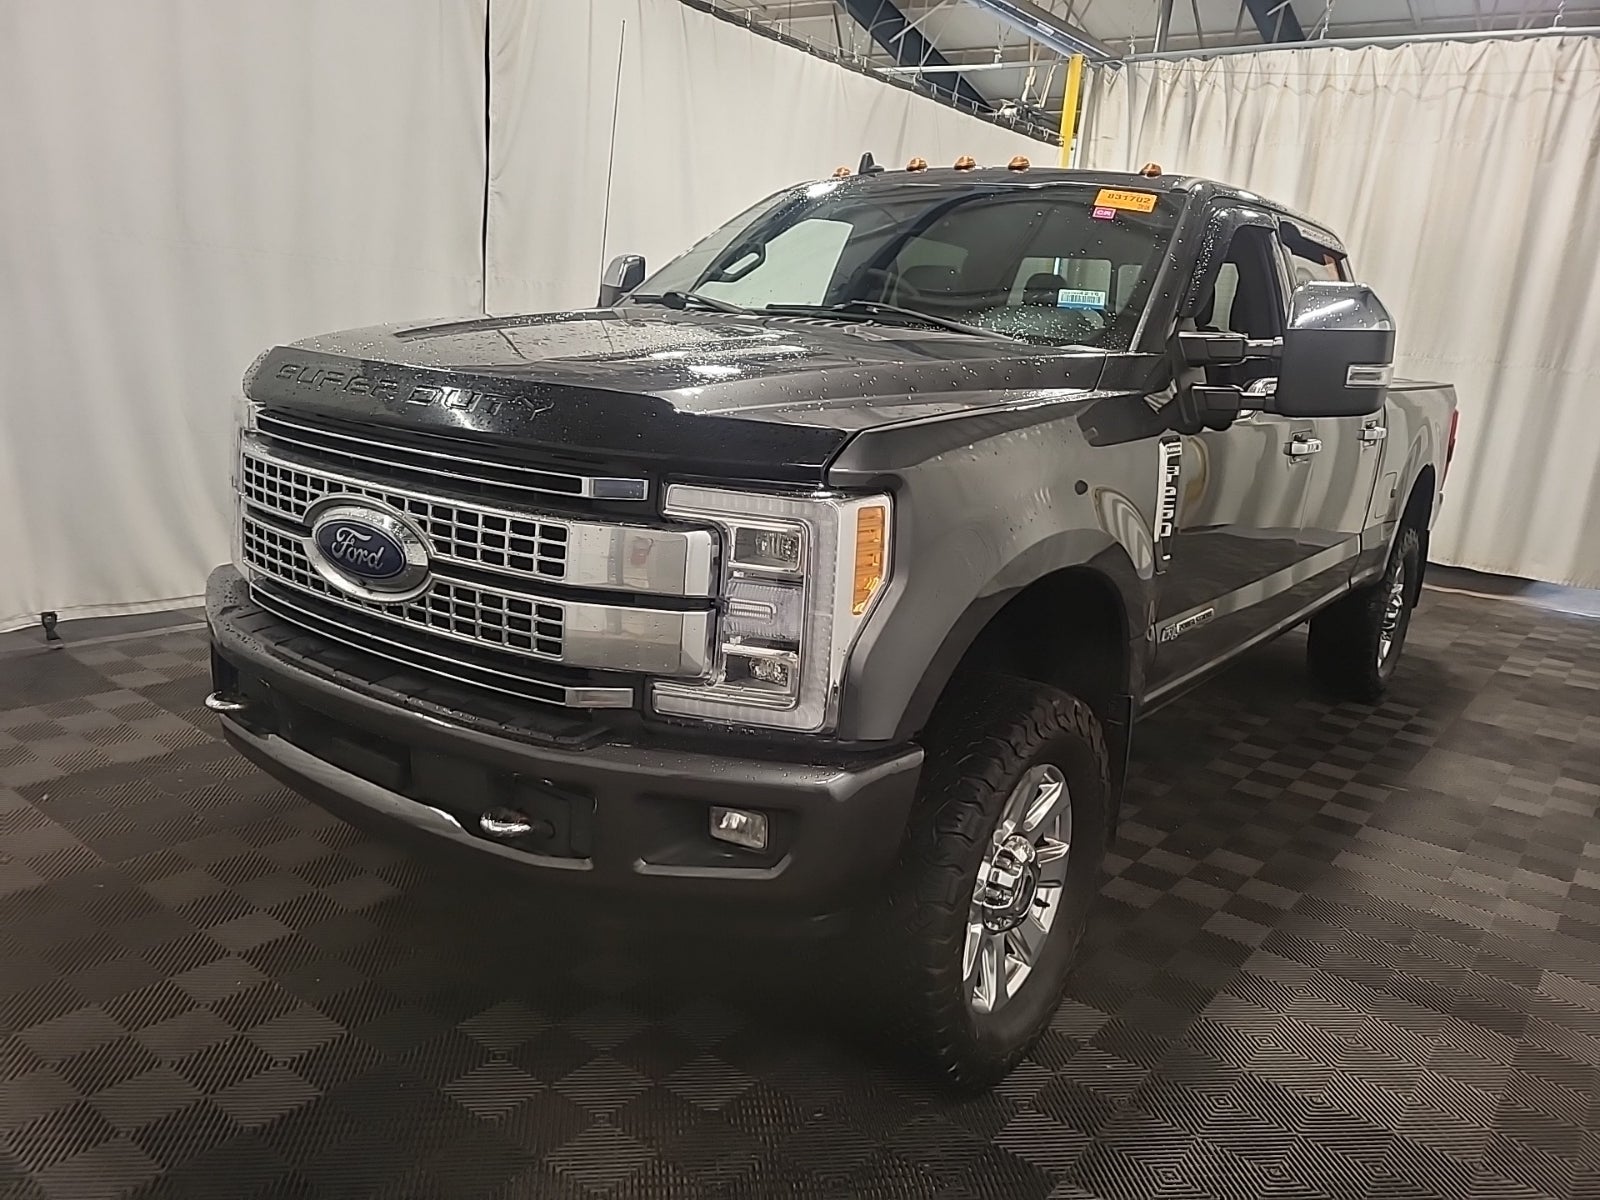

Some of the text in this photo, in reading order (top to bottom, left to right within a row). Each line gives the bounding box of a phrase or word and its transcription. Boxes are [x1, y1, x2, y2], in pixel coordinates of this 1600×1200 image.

[1107, 193, 1151, 204] 831702
[275, 363, 555, 421] SUPER DUTY
[331, 526, 385, 570] Ford
